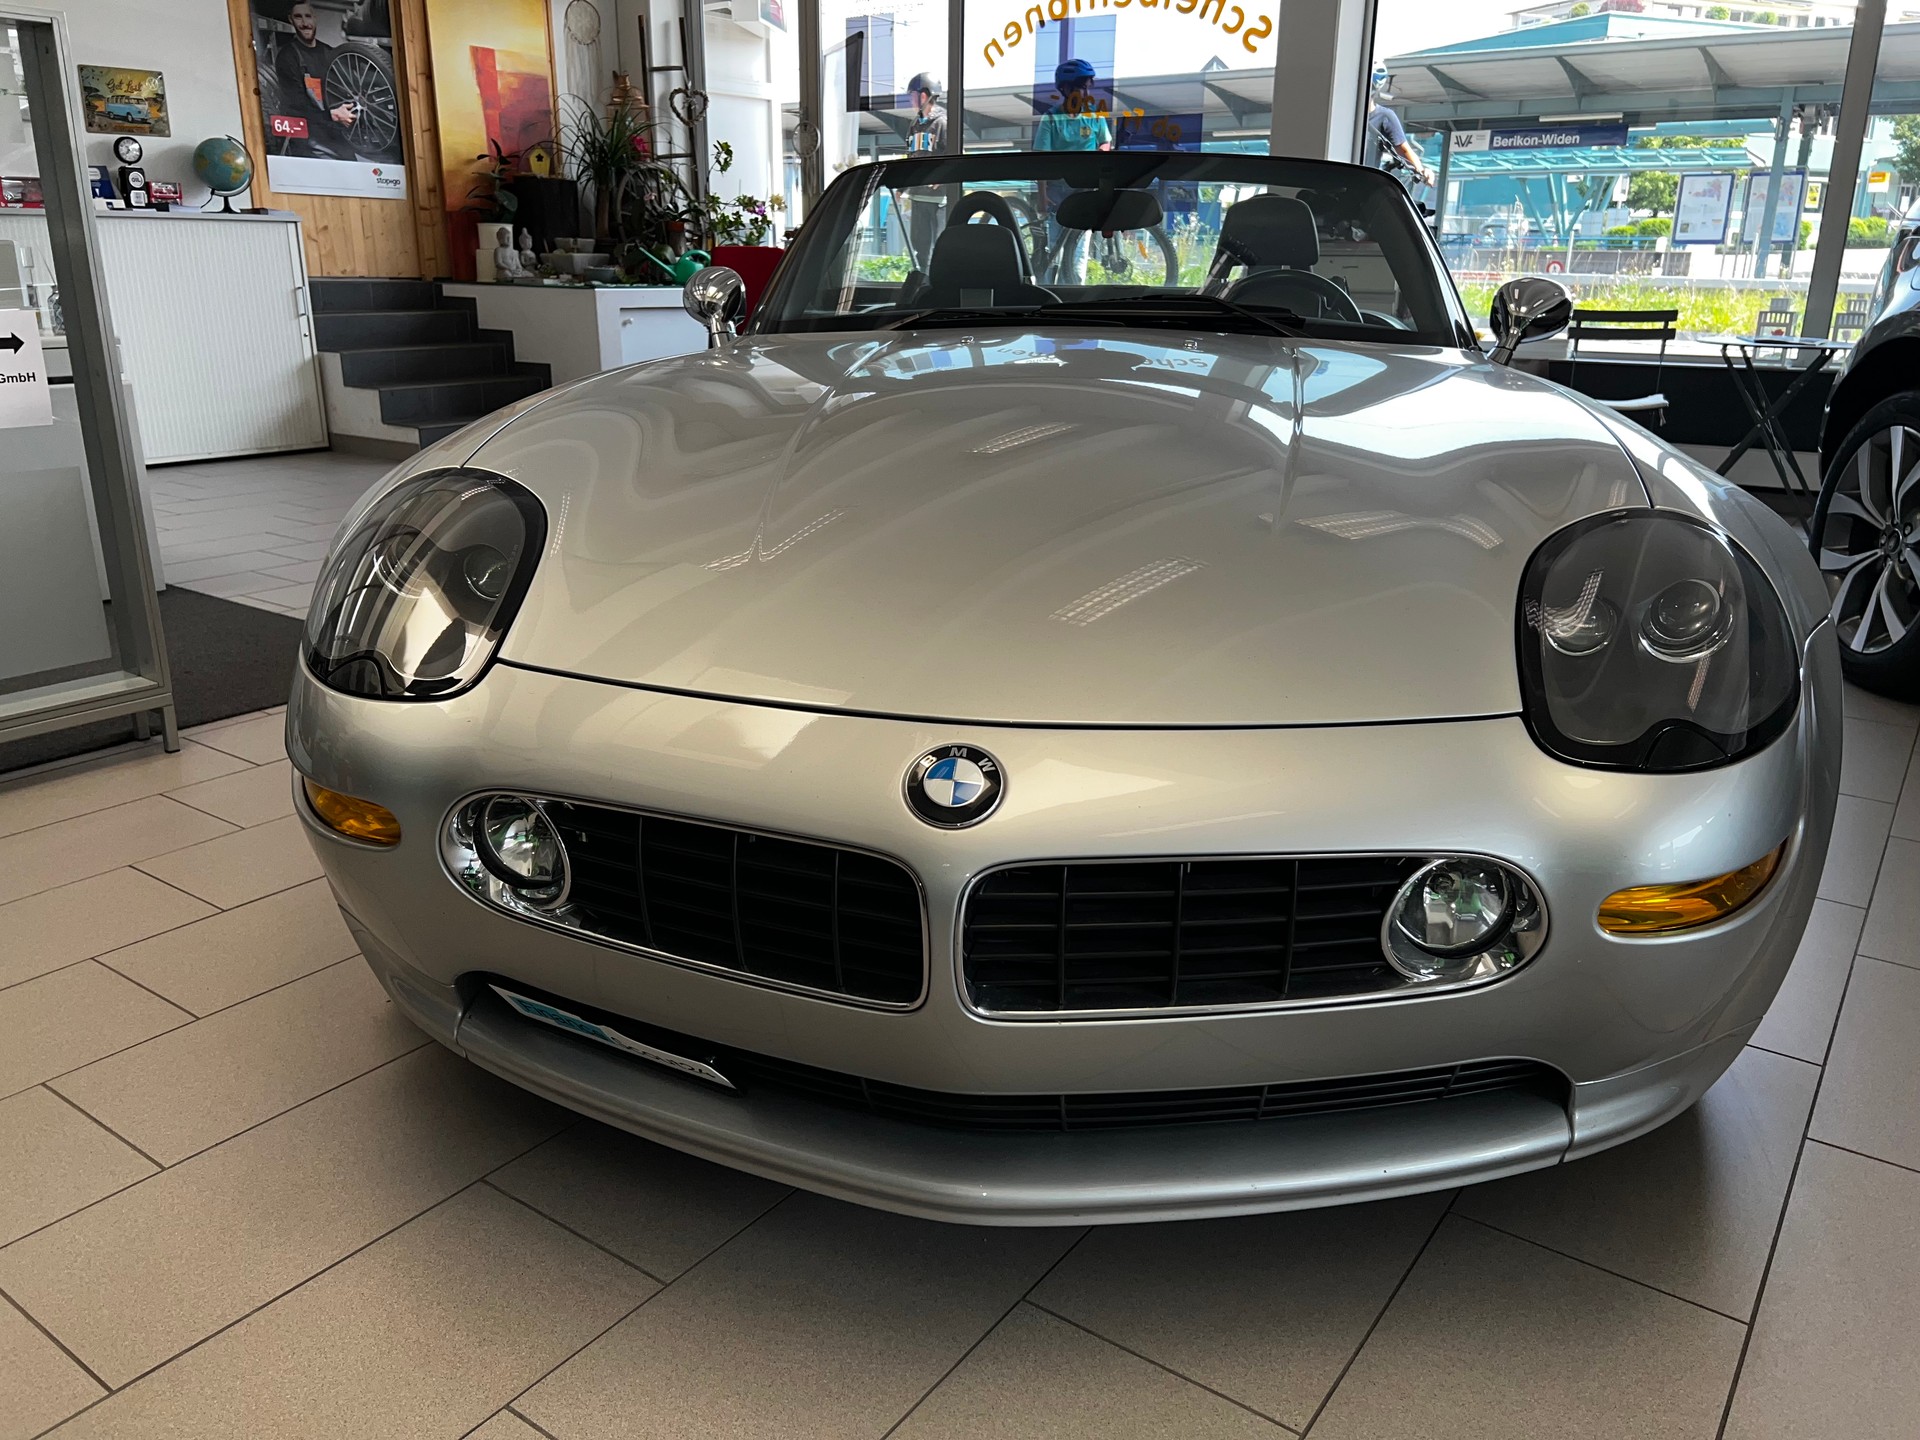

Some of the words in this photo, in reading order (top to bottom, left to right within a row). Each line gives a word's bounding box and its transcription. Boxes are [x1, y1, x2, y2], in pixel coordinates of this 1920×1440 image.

[106, 78, 123, 93] Get
[124, 79, 143, 94] Lost
[1493, 133, 1580, 147] Berikon-Widen
[0, 372, 36, 384] GmbH
[919, 747, 997, 772] BMW
